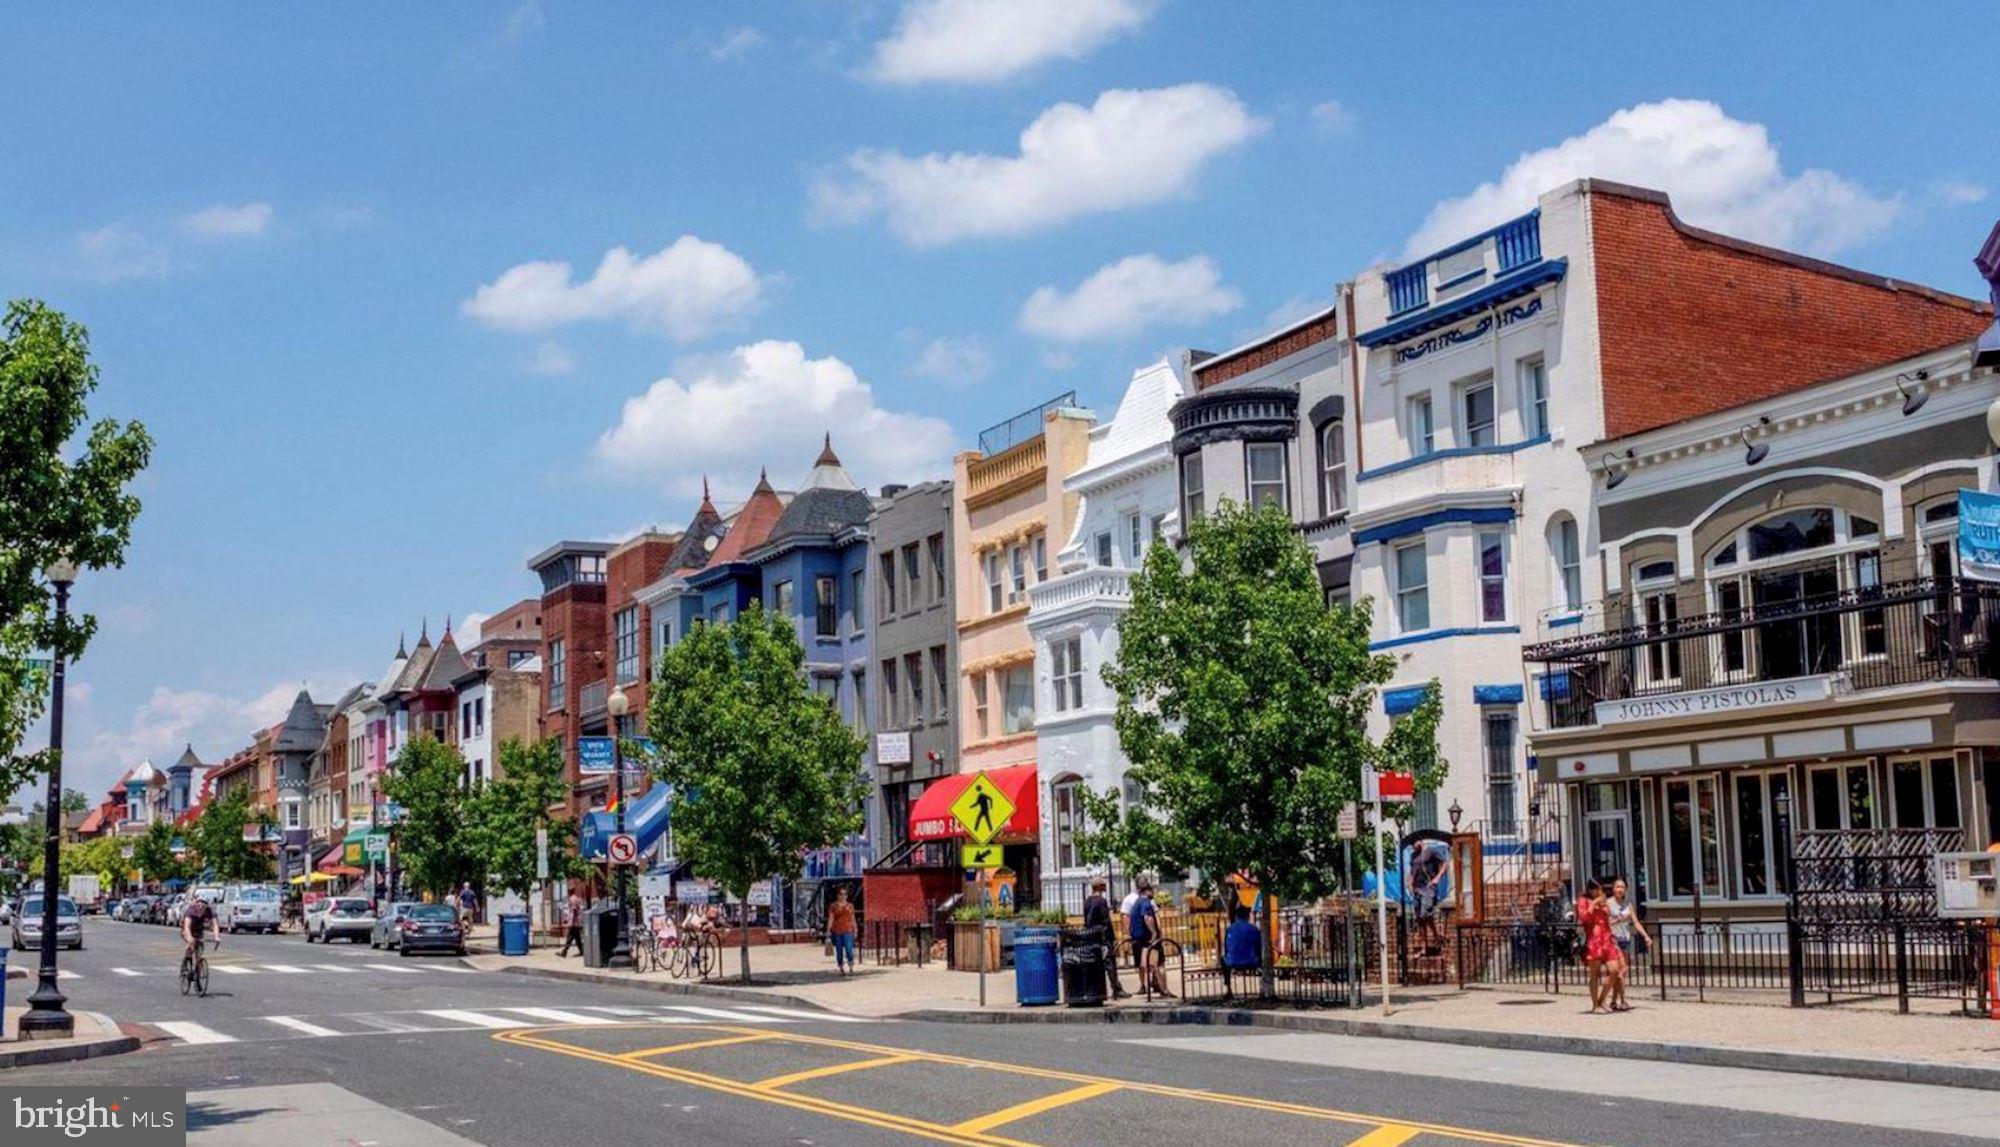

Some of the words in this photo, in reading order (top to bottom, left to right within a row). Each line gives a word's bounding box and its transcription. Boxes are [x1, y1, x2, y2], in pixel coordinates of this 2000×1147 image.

[1619, 698, 1693, 720] JOHNNY
[1700, 684, 1797, 710] PISTOLAS
[914, 819, 945, 837] JUMBO
